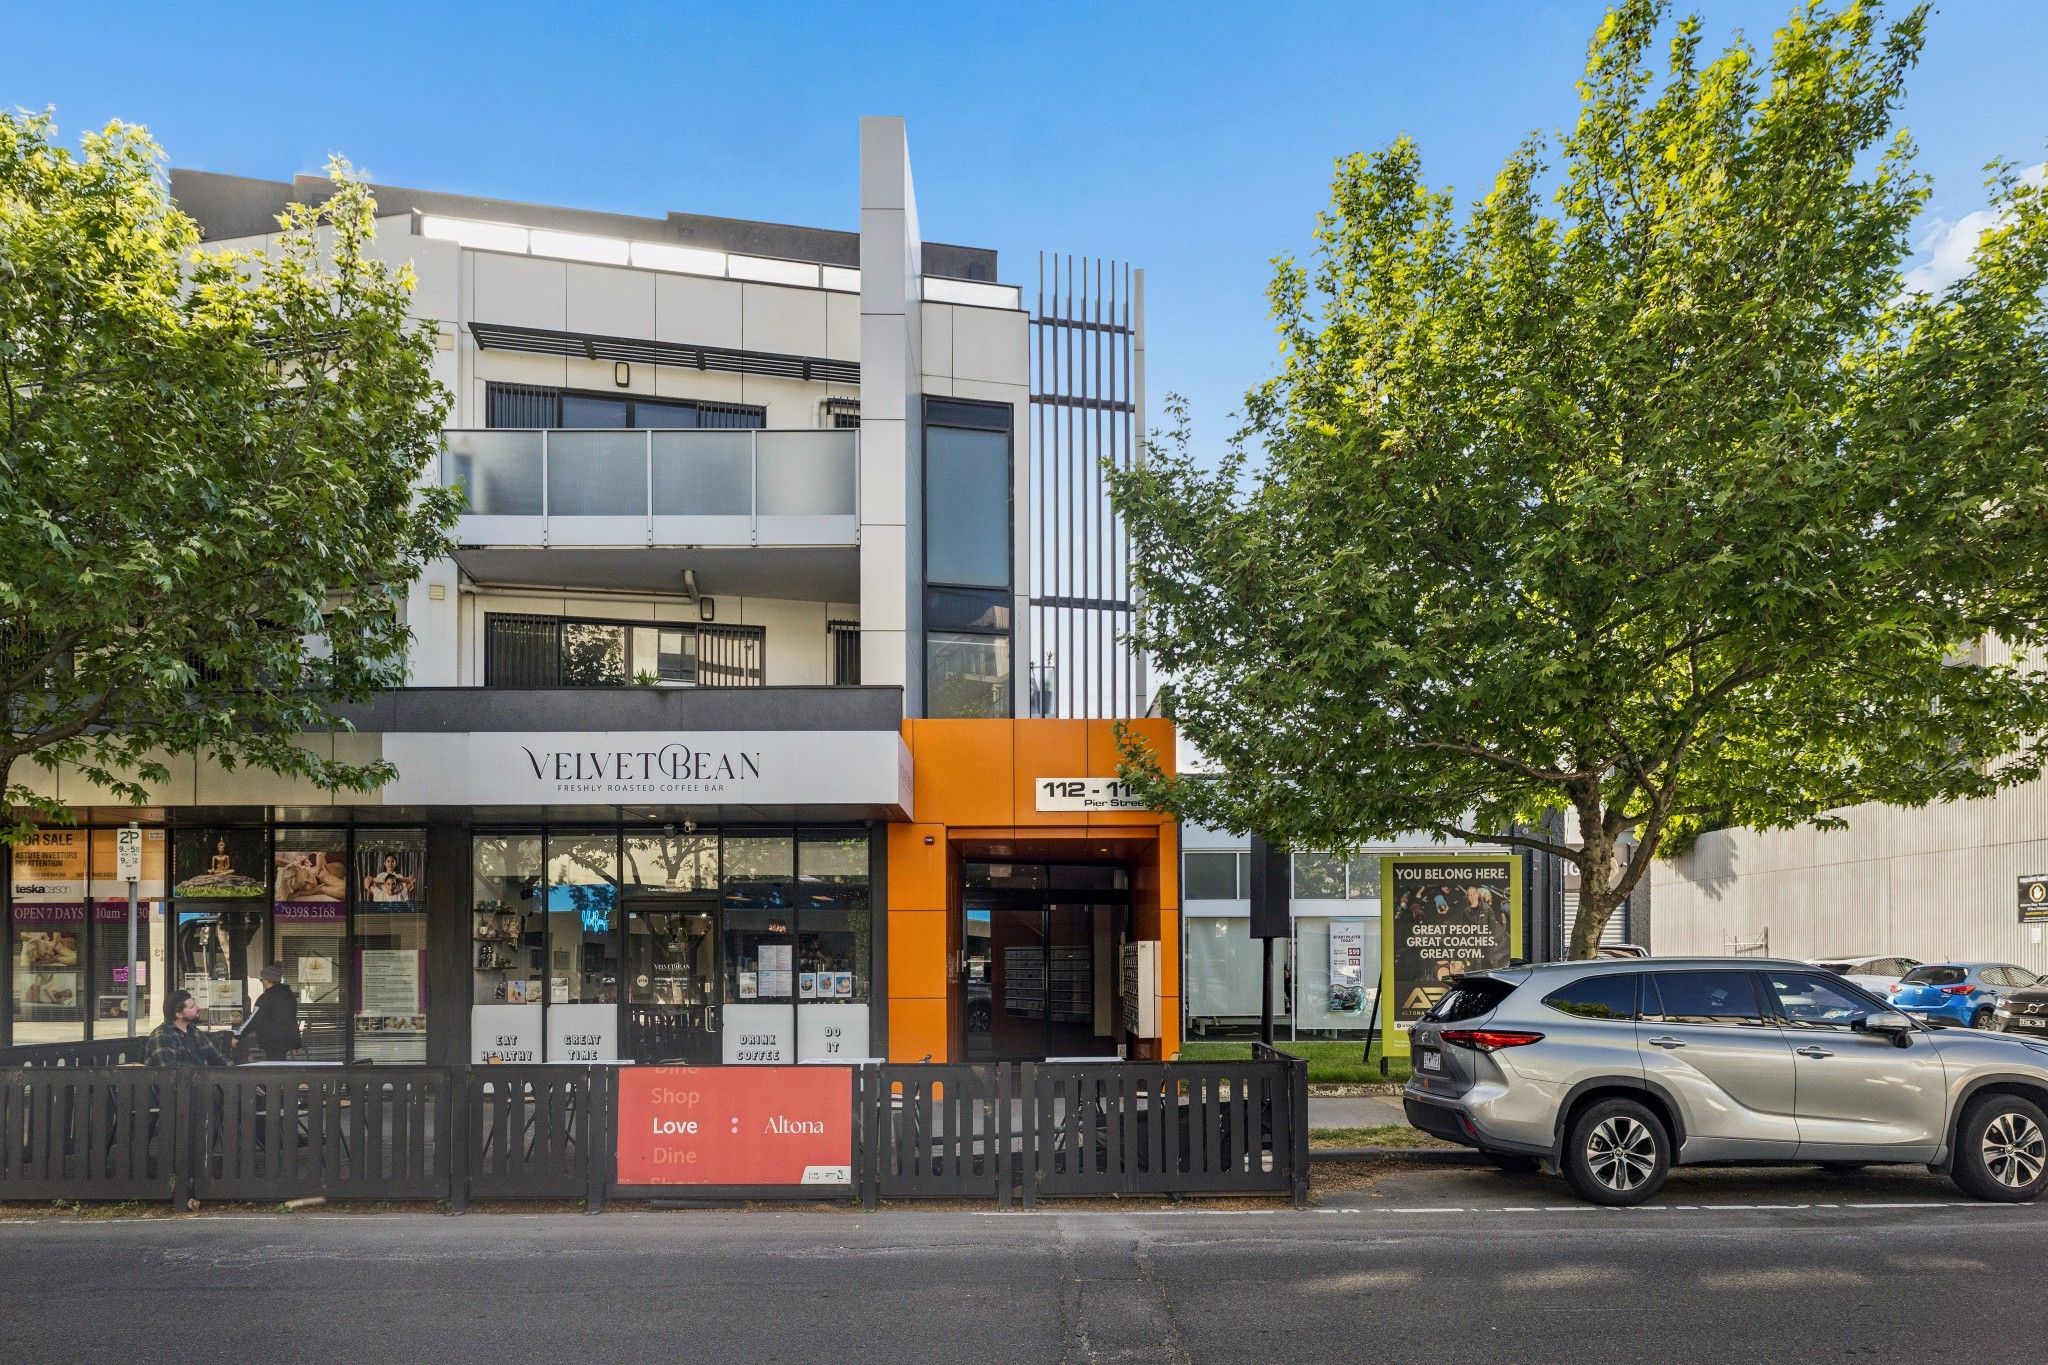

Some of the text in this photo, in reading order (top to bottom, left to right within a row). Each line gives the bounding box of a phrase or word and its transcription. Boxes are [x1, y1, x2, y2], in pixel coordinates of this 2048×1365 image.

[522, 743, 761, 780] VELVET BEAN
[557, 784, 725, 792] FRESHLY ROASTED COFFEE BAR
[1043, 782, 1086, 798] 112
[1084, 799, 1108, 807] Pier
[43, 833, 73, 846] SALE
[119, 831, 140, 844] 2P
[15, 851, 78, 860] ASTUTE INVESTORS
[1395, 868, 1509, 880] YOU BELONG HERE.
[14, 907, 84, 920] OPEN 7 DAYS
[96, 907, 121, 919] 10am
[285, 906, 336, 918] 9398 5168
[1412, 924, 1492, 935] GREAT PEOPLE.
[1406, 936, 1498, 947] GREAT COACHES.
[1420, 948, 1485, 959] GREAT GYM.
[824, 1026, 841, 1038] DO
[496, 1035, 517, 1046] EAT
[564, 1035, 602, 1046] GREAT
[739, 1034, 777, 1046] DRINK
[826, 1042, 840, 1053] IT
[568, 1050, 598, 1061] TIME
[736, 1050, 780, 1061] COFFEE
[651, 1087, 700, 1108] Shop
[653, 1117, 698, 1134] Love
[763, 1115, 824, 1134] Altona
[653, 1147, 697, 1164] Dine
